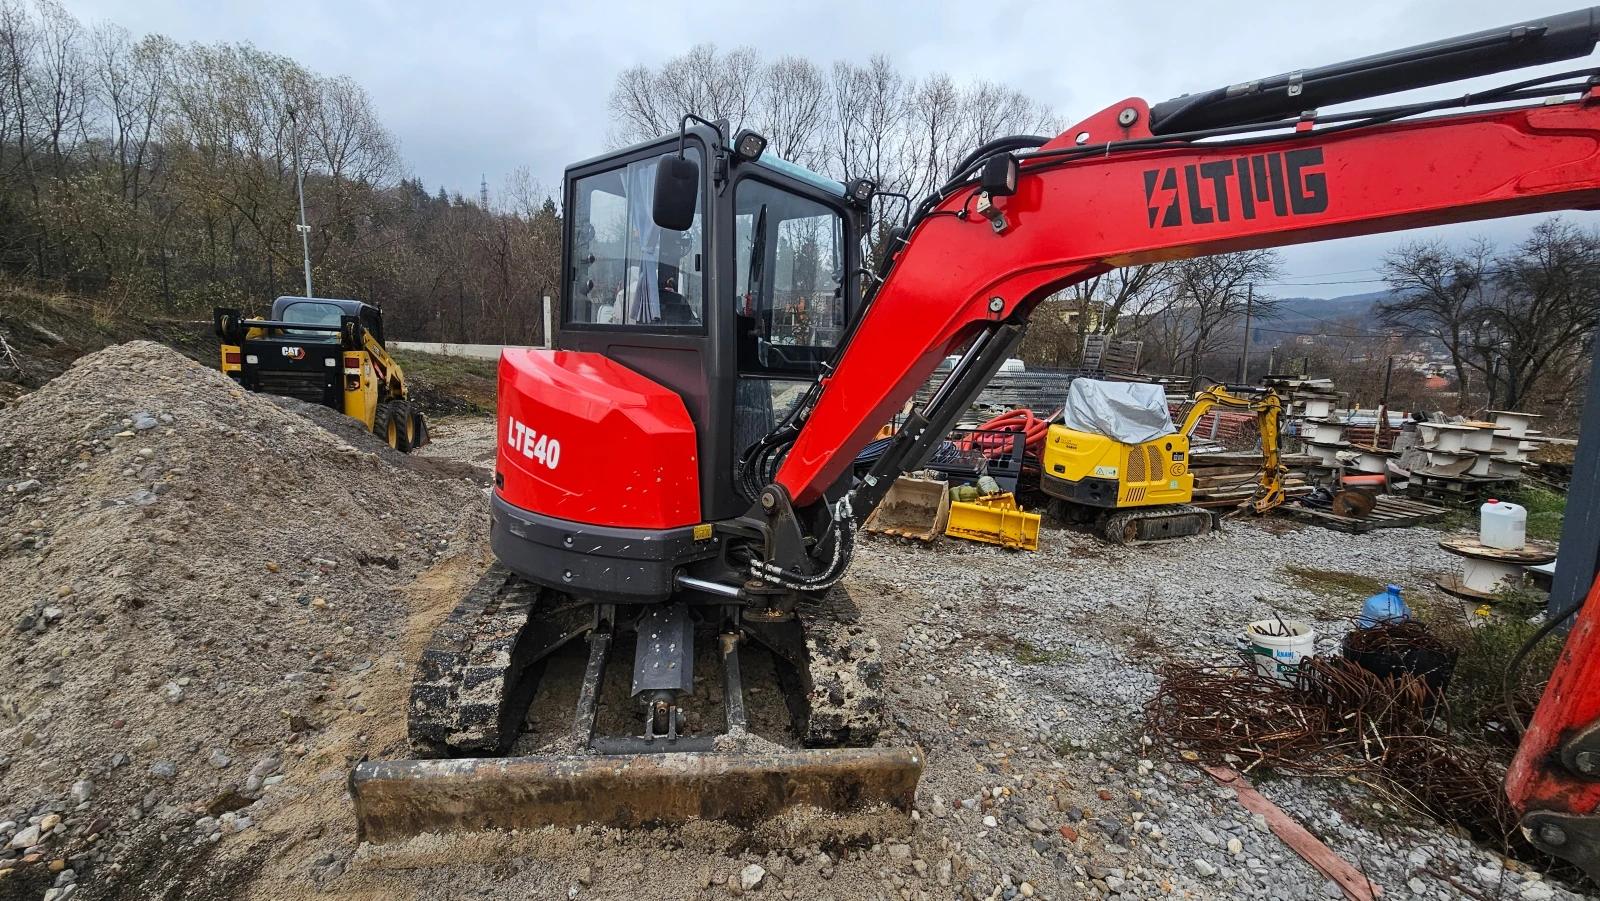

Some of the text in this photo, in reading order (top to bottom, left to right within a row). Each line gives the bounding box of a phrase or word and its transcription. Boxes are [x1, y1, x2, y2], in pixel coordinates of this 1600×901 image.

[1185, 147, 1328, 224] LTMG
[282, 346, 300, 357] CAT
[507, 416, 561, 470] LTE40
